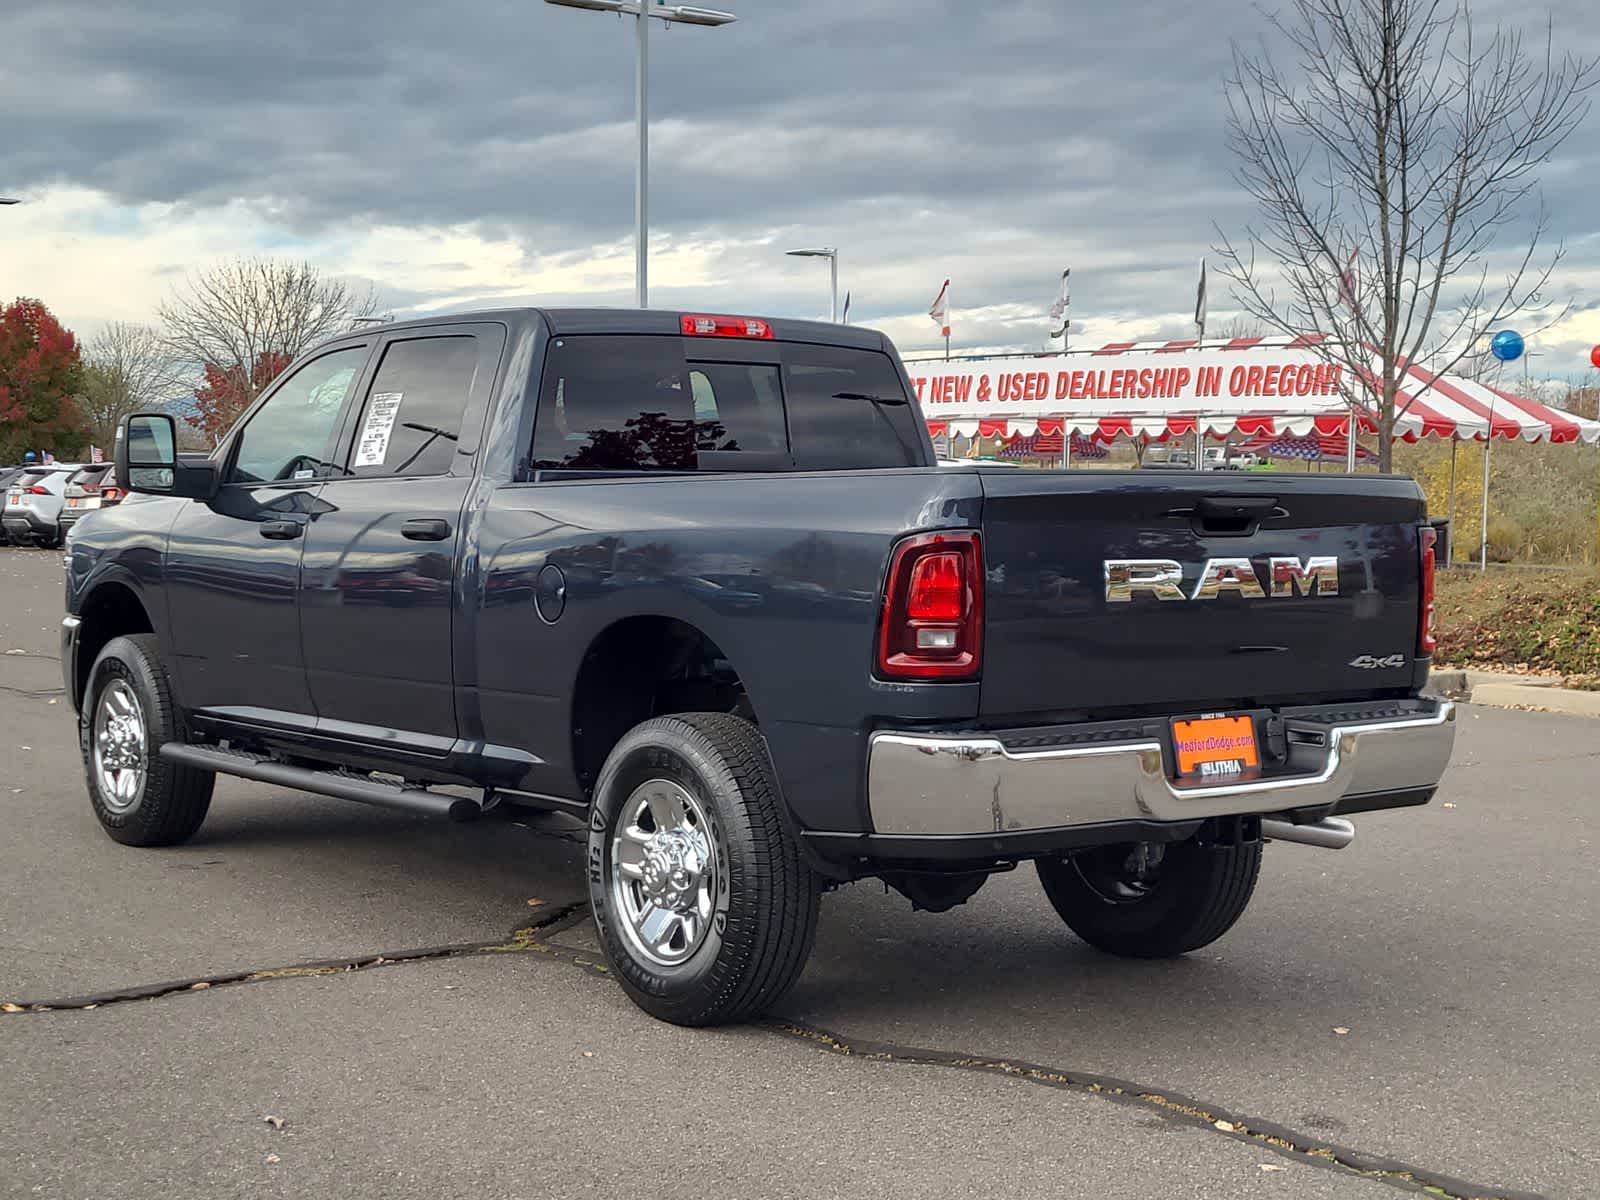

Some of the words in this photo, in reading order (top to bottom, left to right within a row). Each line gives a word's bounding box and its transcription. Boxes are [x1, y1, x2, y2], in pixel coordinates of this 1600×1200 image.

[909, 377, 927, 402] T
[930, 375, 973, 403] NEW
[976, 374, 992, 402] &
[997, 372, 1050, 401] USED
[1055, 367, 1191, 400] DEALERSHIP
[1195, 366, 1224, 397] IN
[1229, 363, 1343, 397] OREGON!
[1103, 556, 1339, 603] RAM
